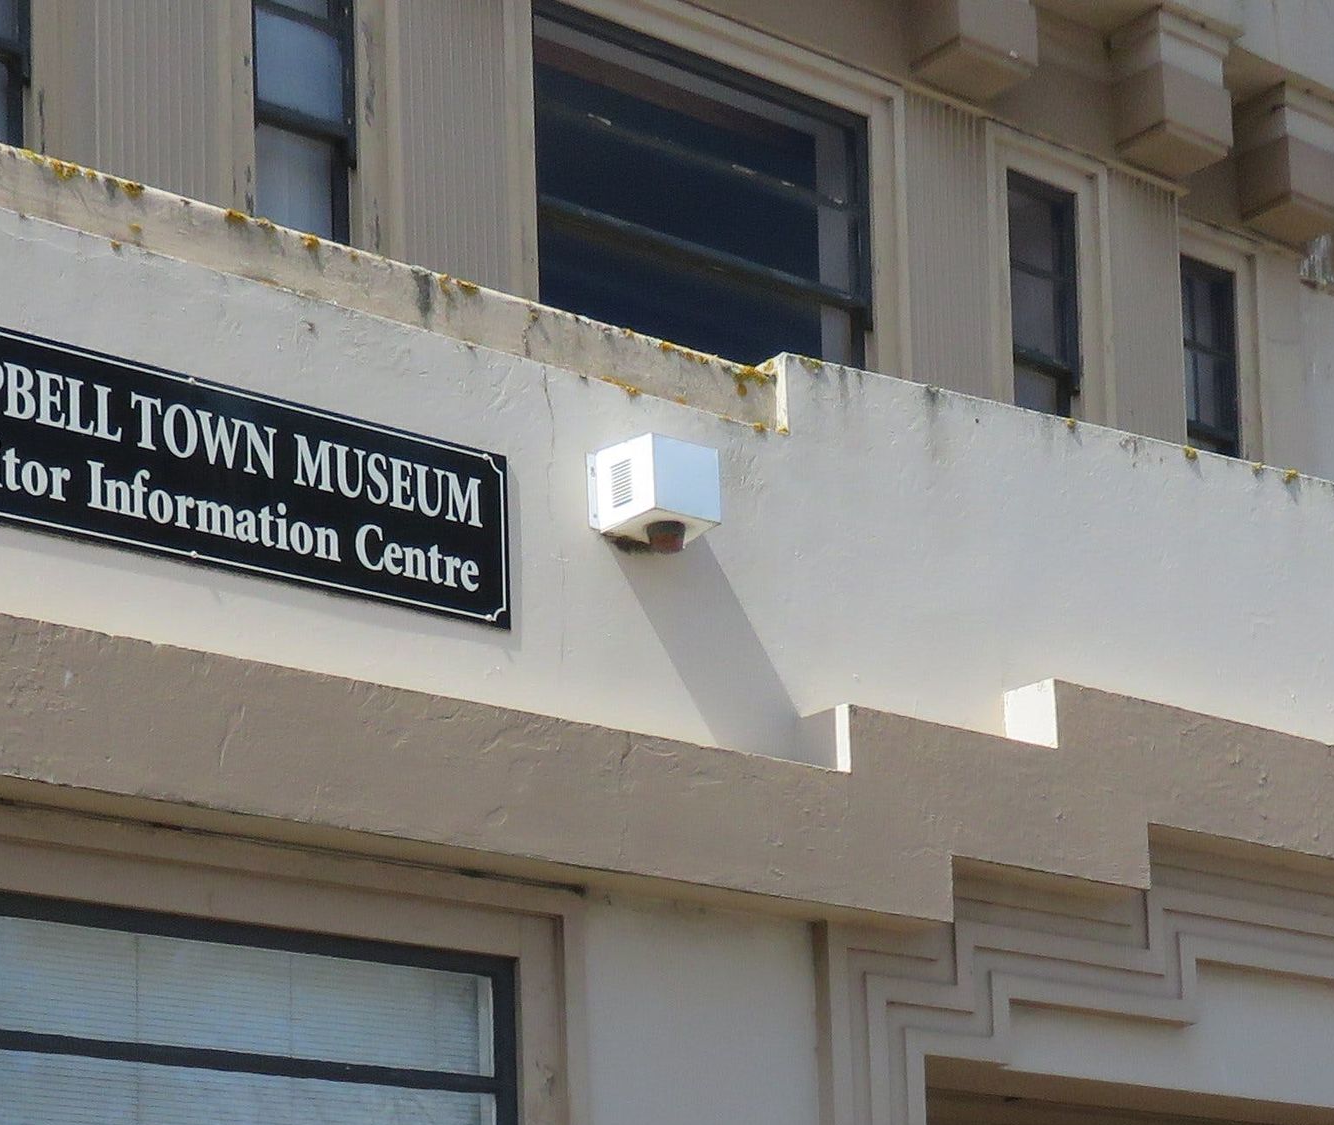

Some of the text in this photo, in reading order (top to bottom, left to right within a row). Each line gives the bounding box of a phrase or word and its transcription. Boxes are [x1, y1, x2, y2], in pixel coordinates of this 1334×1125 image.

[86, 460, 341, 564] Information
[355, 524, 481, 593] Centre
[130, 392, 275, 480] TOWN
[293, 433, 484, 529] MUSEUM
